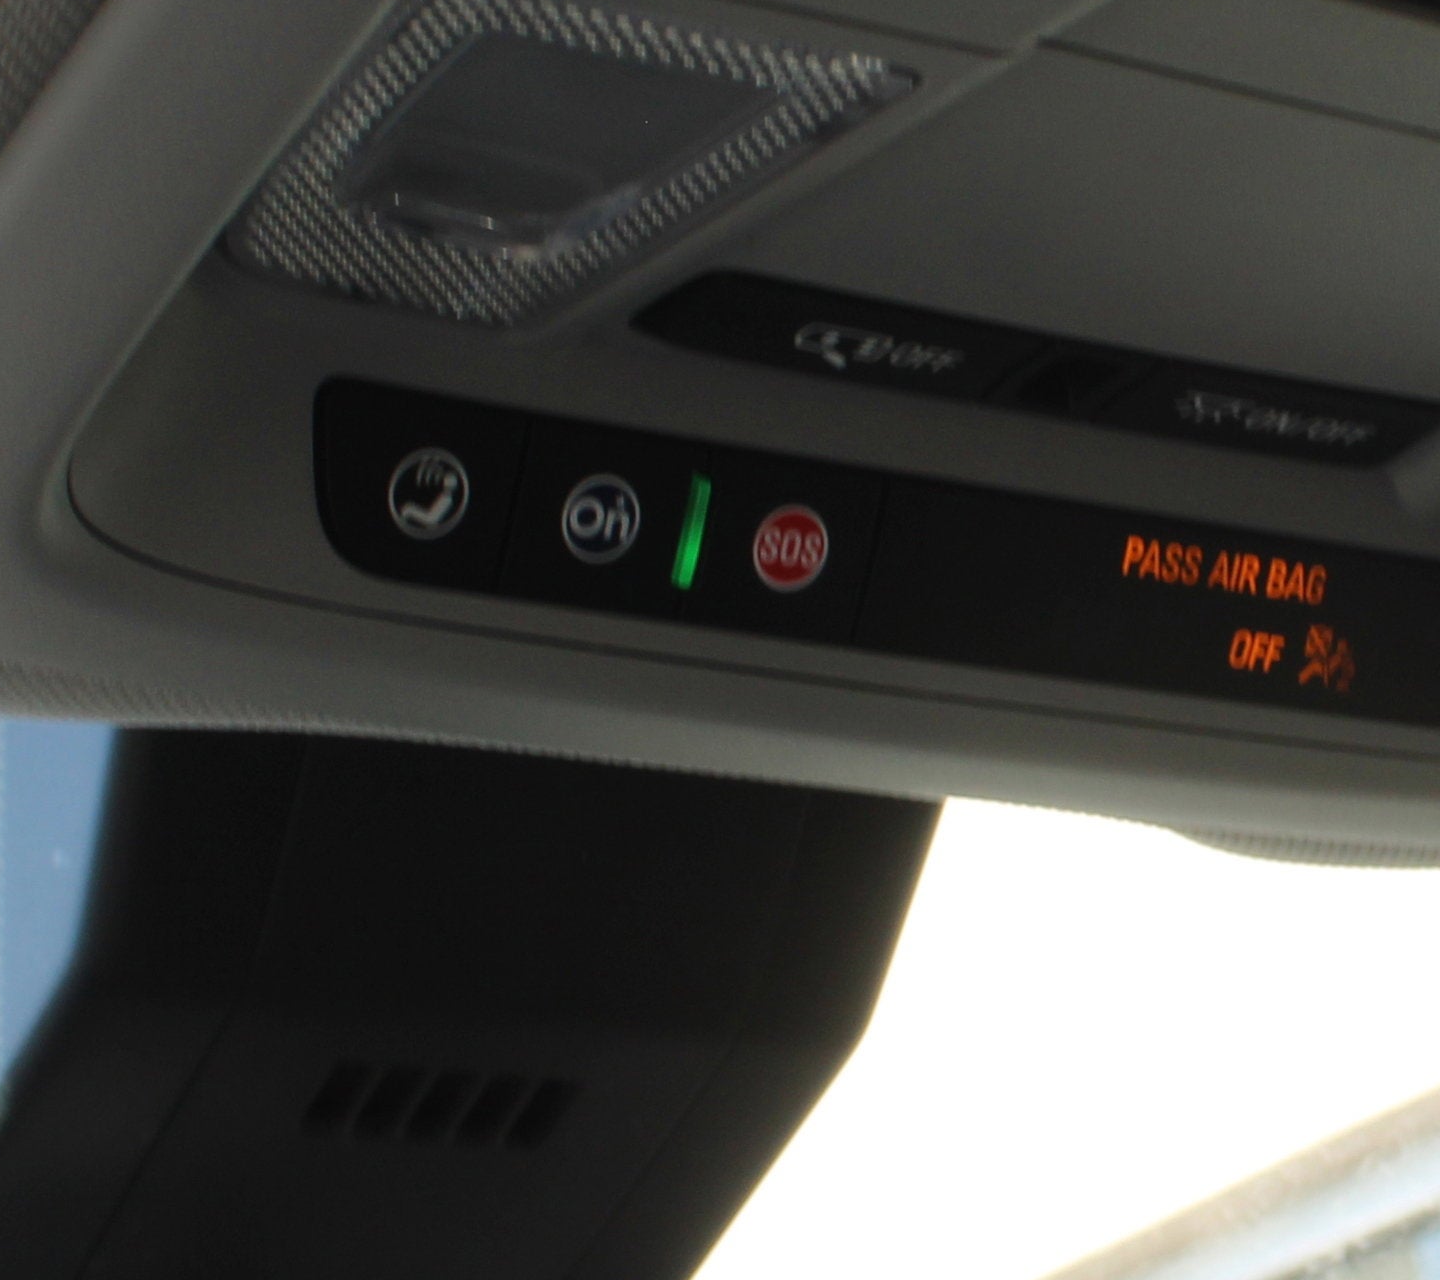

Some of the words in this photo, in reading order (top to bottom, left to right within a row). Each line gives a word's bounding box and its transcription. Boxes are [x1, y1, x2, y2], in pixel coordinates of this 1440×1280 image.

[760, 528, 821, 569] SOS
[1121, 535, 1203, 581] PASS
[1208, 551, 1262, 595] AIR
[1264, 557, 1323, 603] BAG
[1228, 629, 1285, 672] OFF
